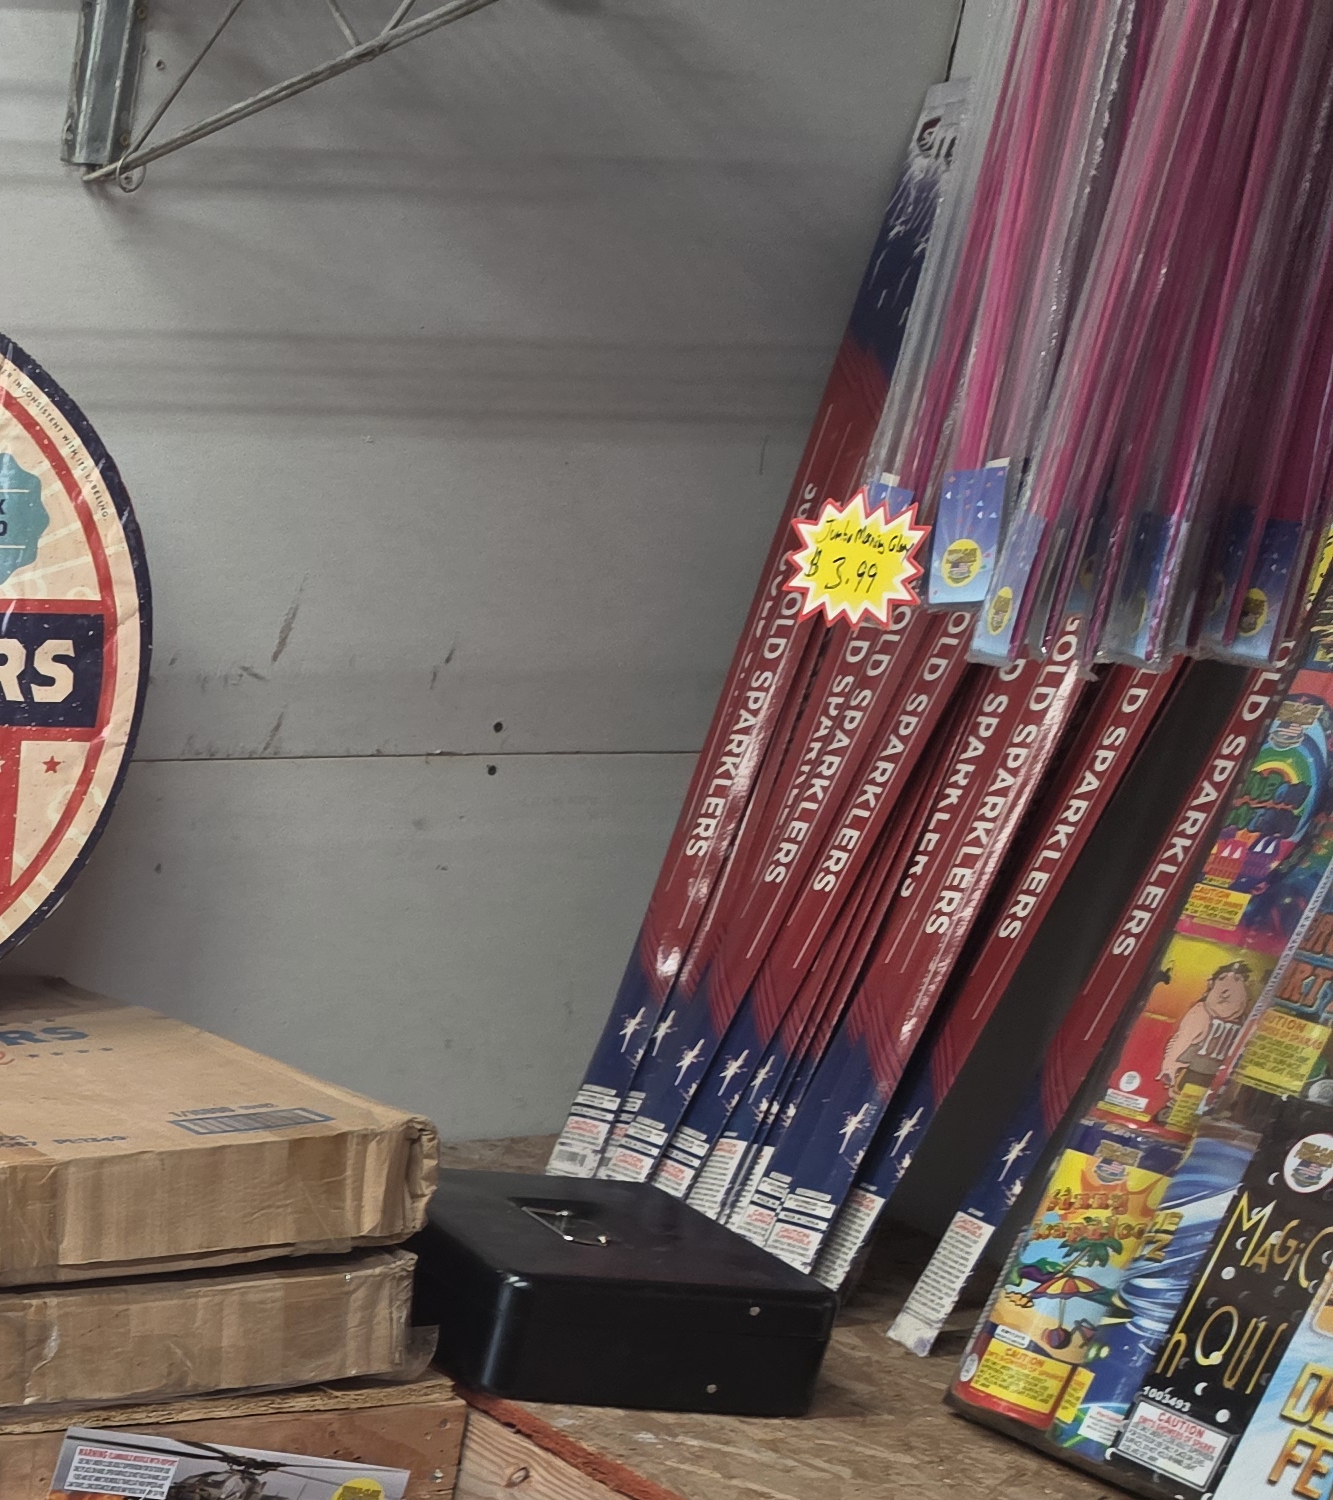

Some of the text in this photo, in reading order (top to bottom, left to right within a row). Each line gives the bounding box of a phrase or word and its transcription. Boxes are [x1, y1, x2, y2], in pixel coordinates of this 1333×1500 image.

[685, 669, 774, 857] SPARKLERS
[763, 687, 873, 884] SPARKLERS
[812, 692, 929, 893] SPARKLERS
[924, 722, 1039, 935] SPARKLERS
[997, 725, 1129, 941] SPARKLERS
[1112, 733, 1248, 957] SPARKLERS
[1156, 1410, 1206, 1439] CAUTION
